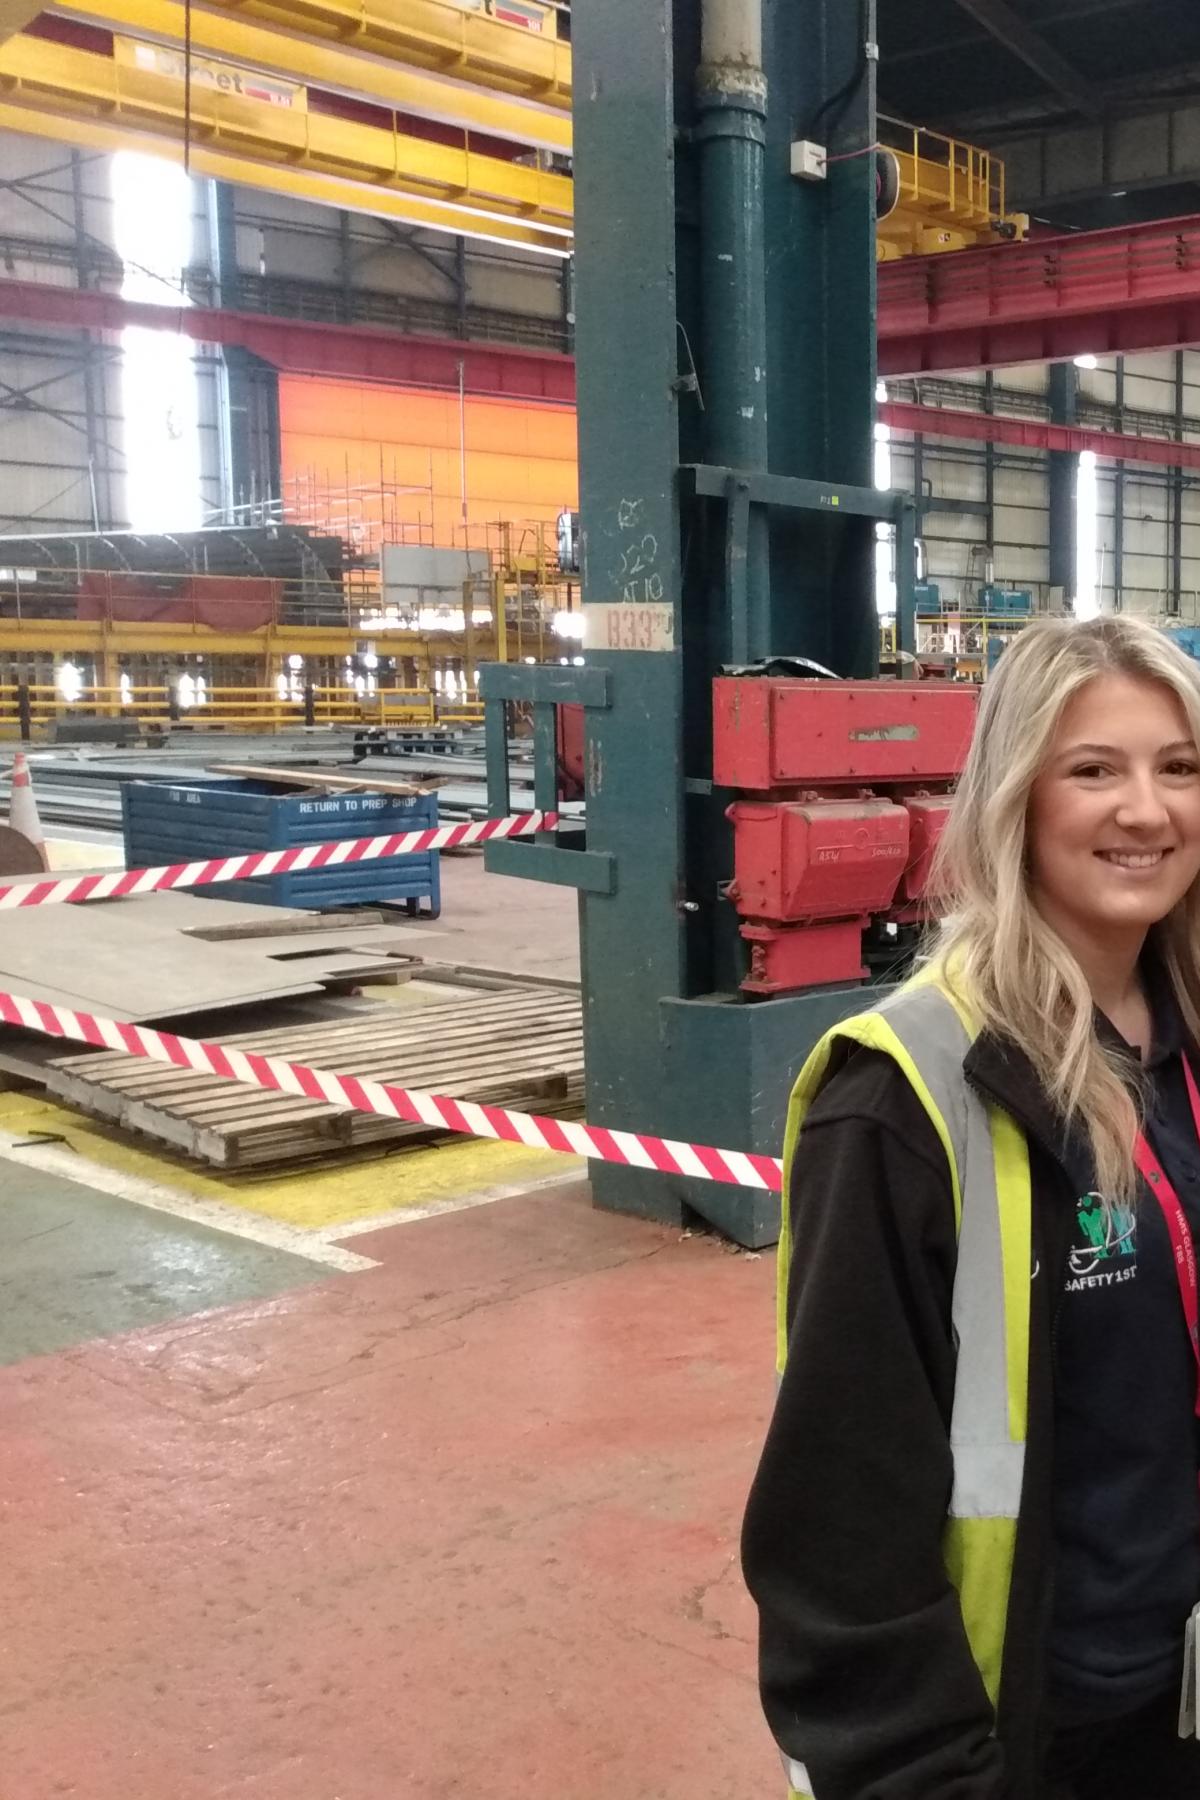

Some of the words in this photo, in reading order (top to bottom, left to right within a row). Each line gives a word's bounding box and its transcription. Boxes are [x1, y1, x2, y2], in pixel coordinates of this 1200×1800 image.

[299, 800, 340, 814] RETURN
[344, 799, 358, 811] TO
[362, 798, 388, 810] PREP
[391, 796, 417, 808] SHOP
[1175, 1208, 1187, 1236] HMS
[1183, 1236, 1196, 1287] GLASGOW
[1064, 1272, 1113, 1292] SAFETY
[1114, 1265, 1137, 1283] 1ST
